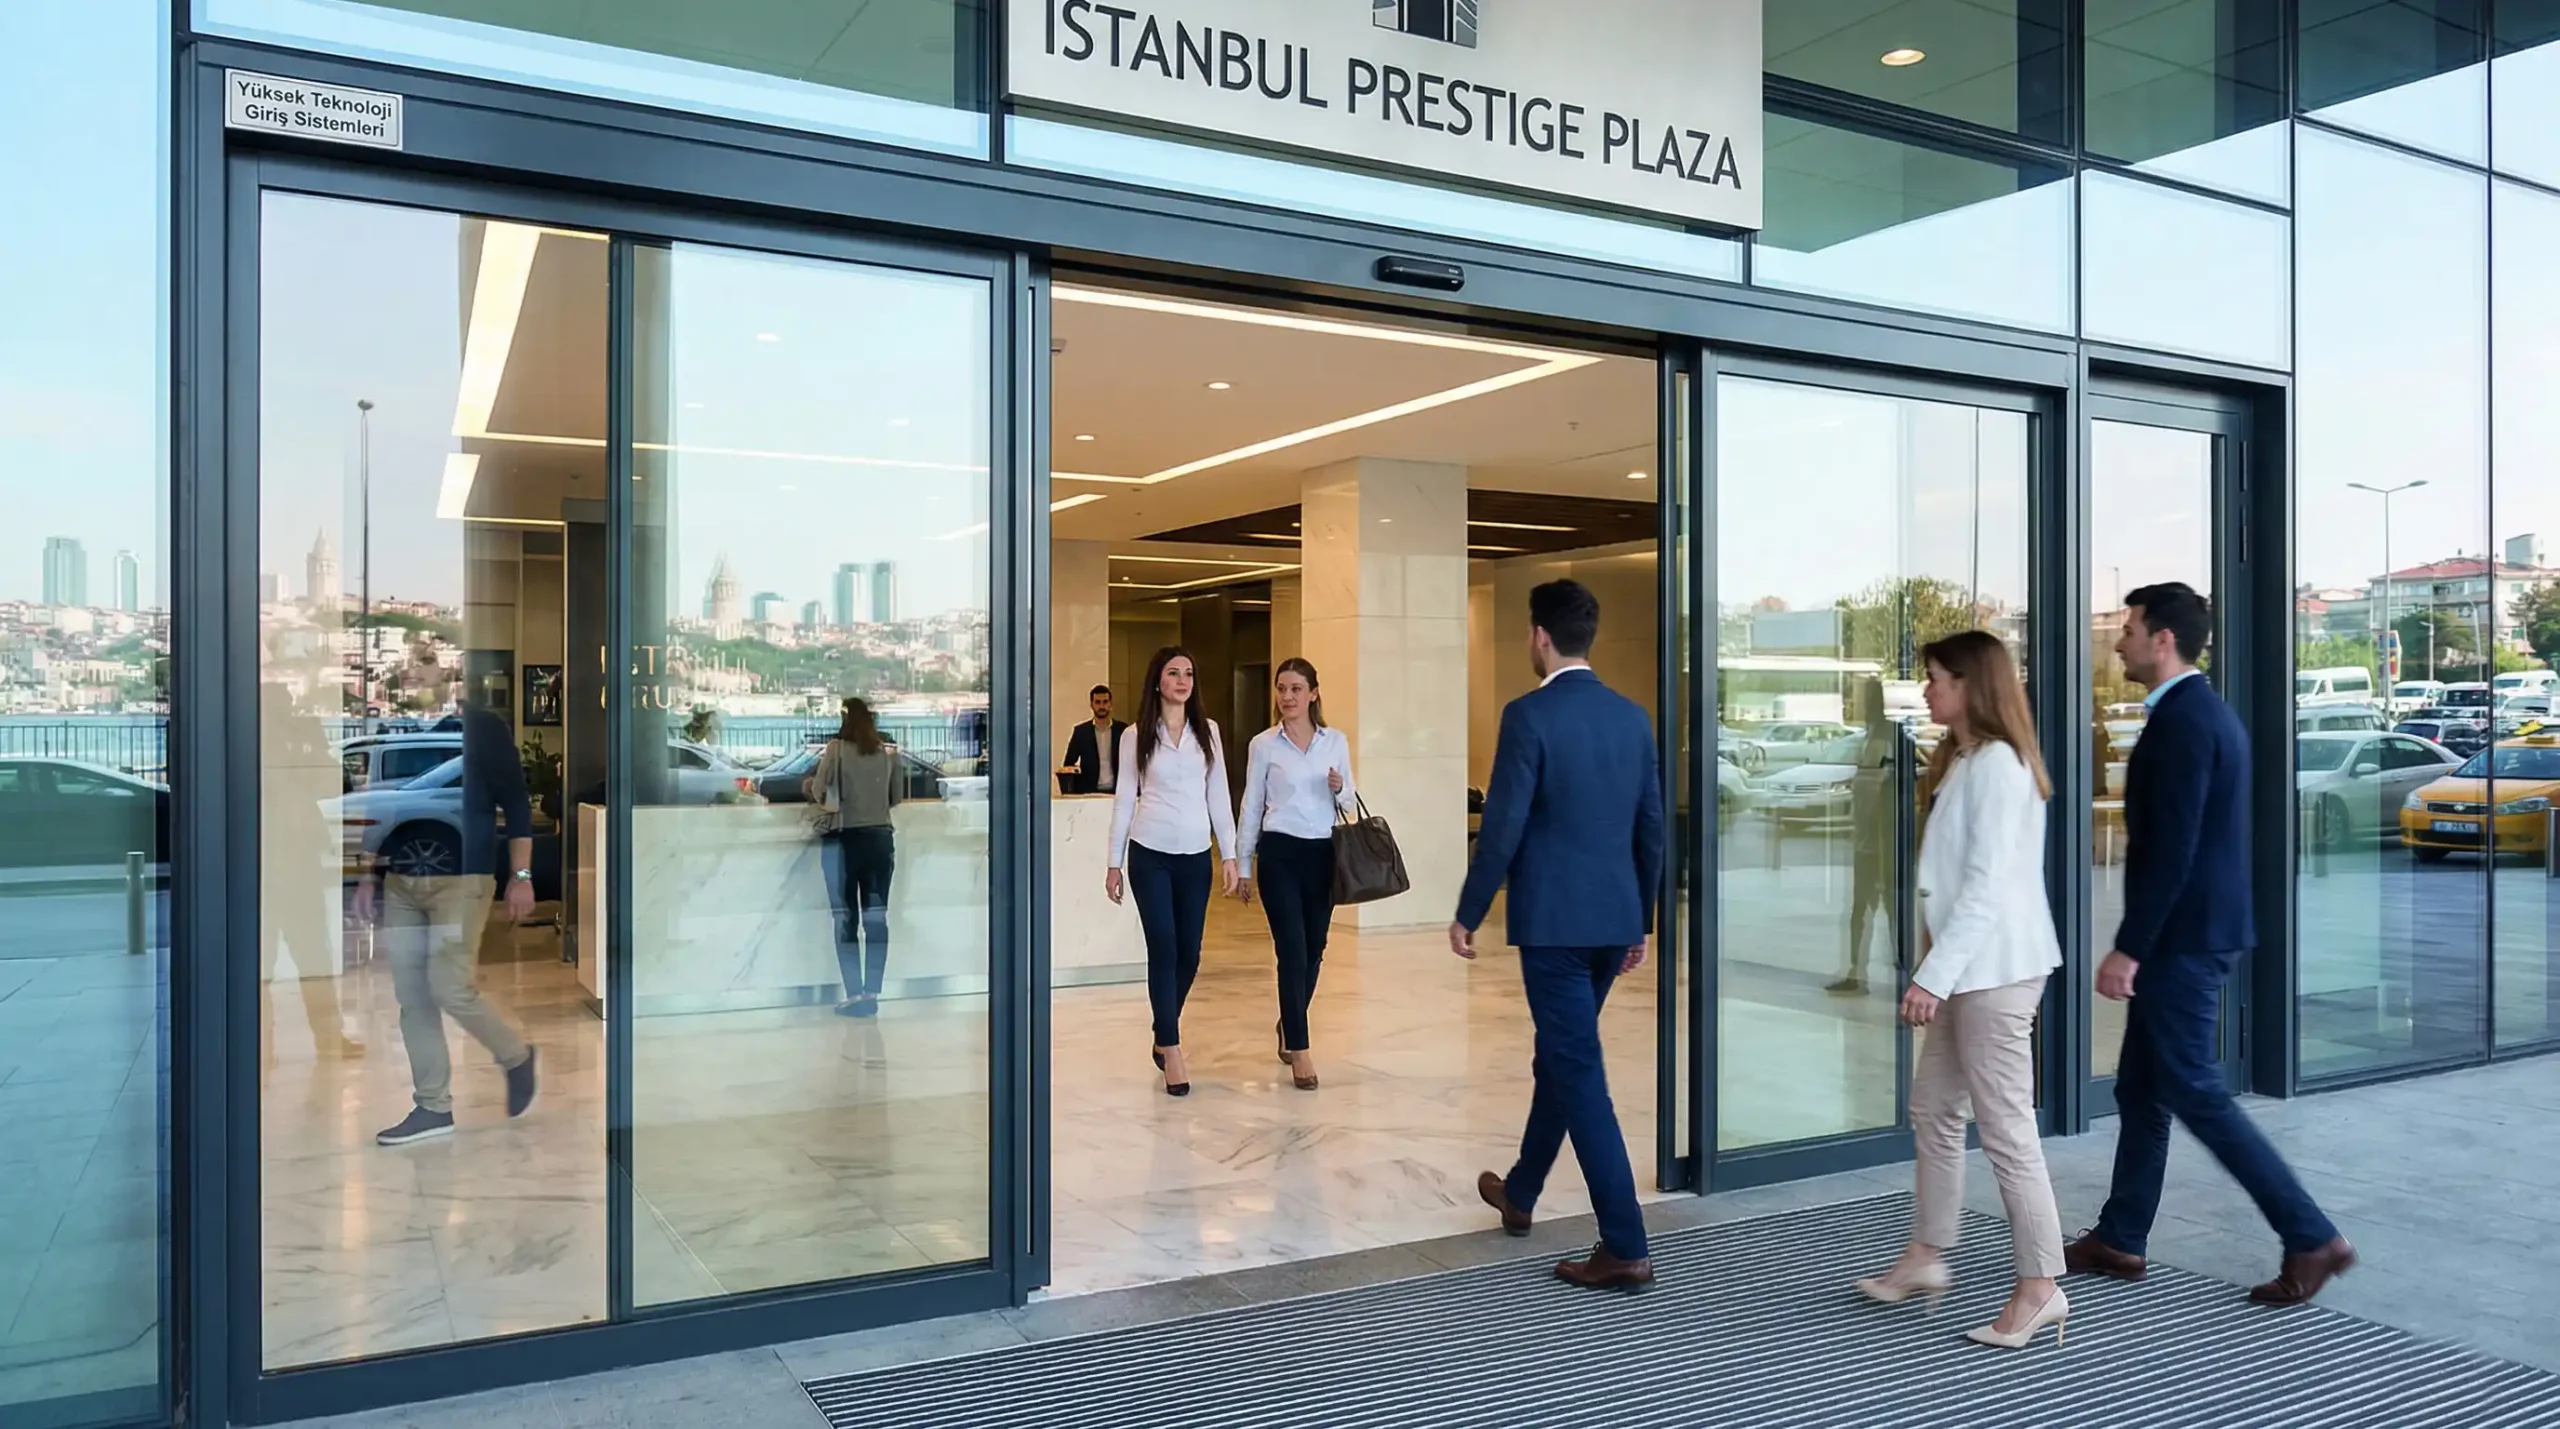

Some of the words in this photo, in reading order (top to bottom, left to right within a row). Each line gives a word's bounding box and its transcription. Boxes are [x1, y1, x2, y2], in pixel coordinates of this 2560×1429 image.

[237, 81, 305, 105] Yüksek
[310, 92, 391, 121] Teknoloji
[245, 104, 288, 127] Giriş
[294, 111, 384, 137] Sistemleri
[1348, 57, 1585, 160] PRESTIGE
[1603, 111, 1742, 190] PLAZA
